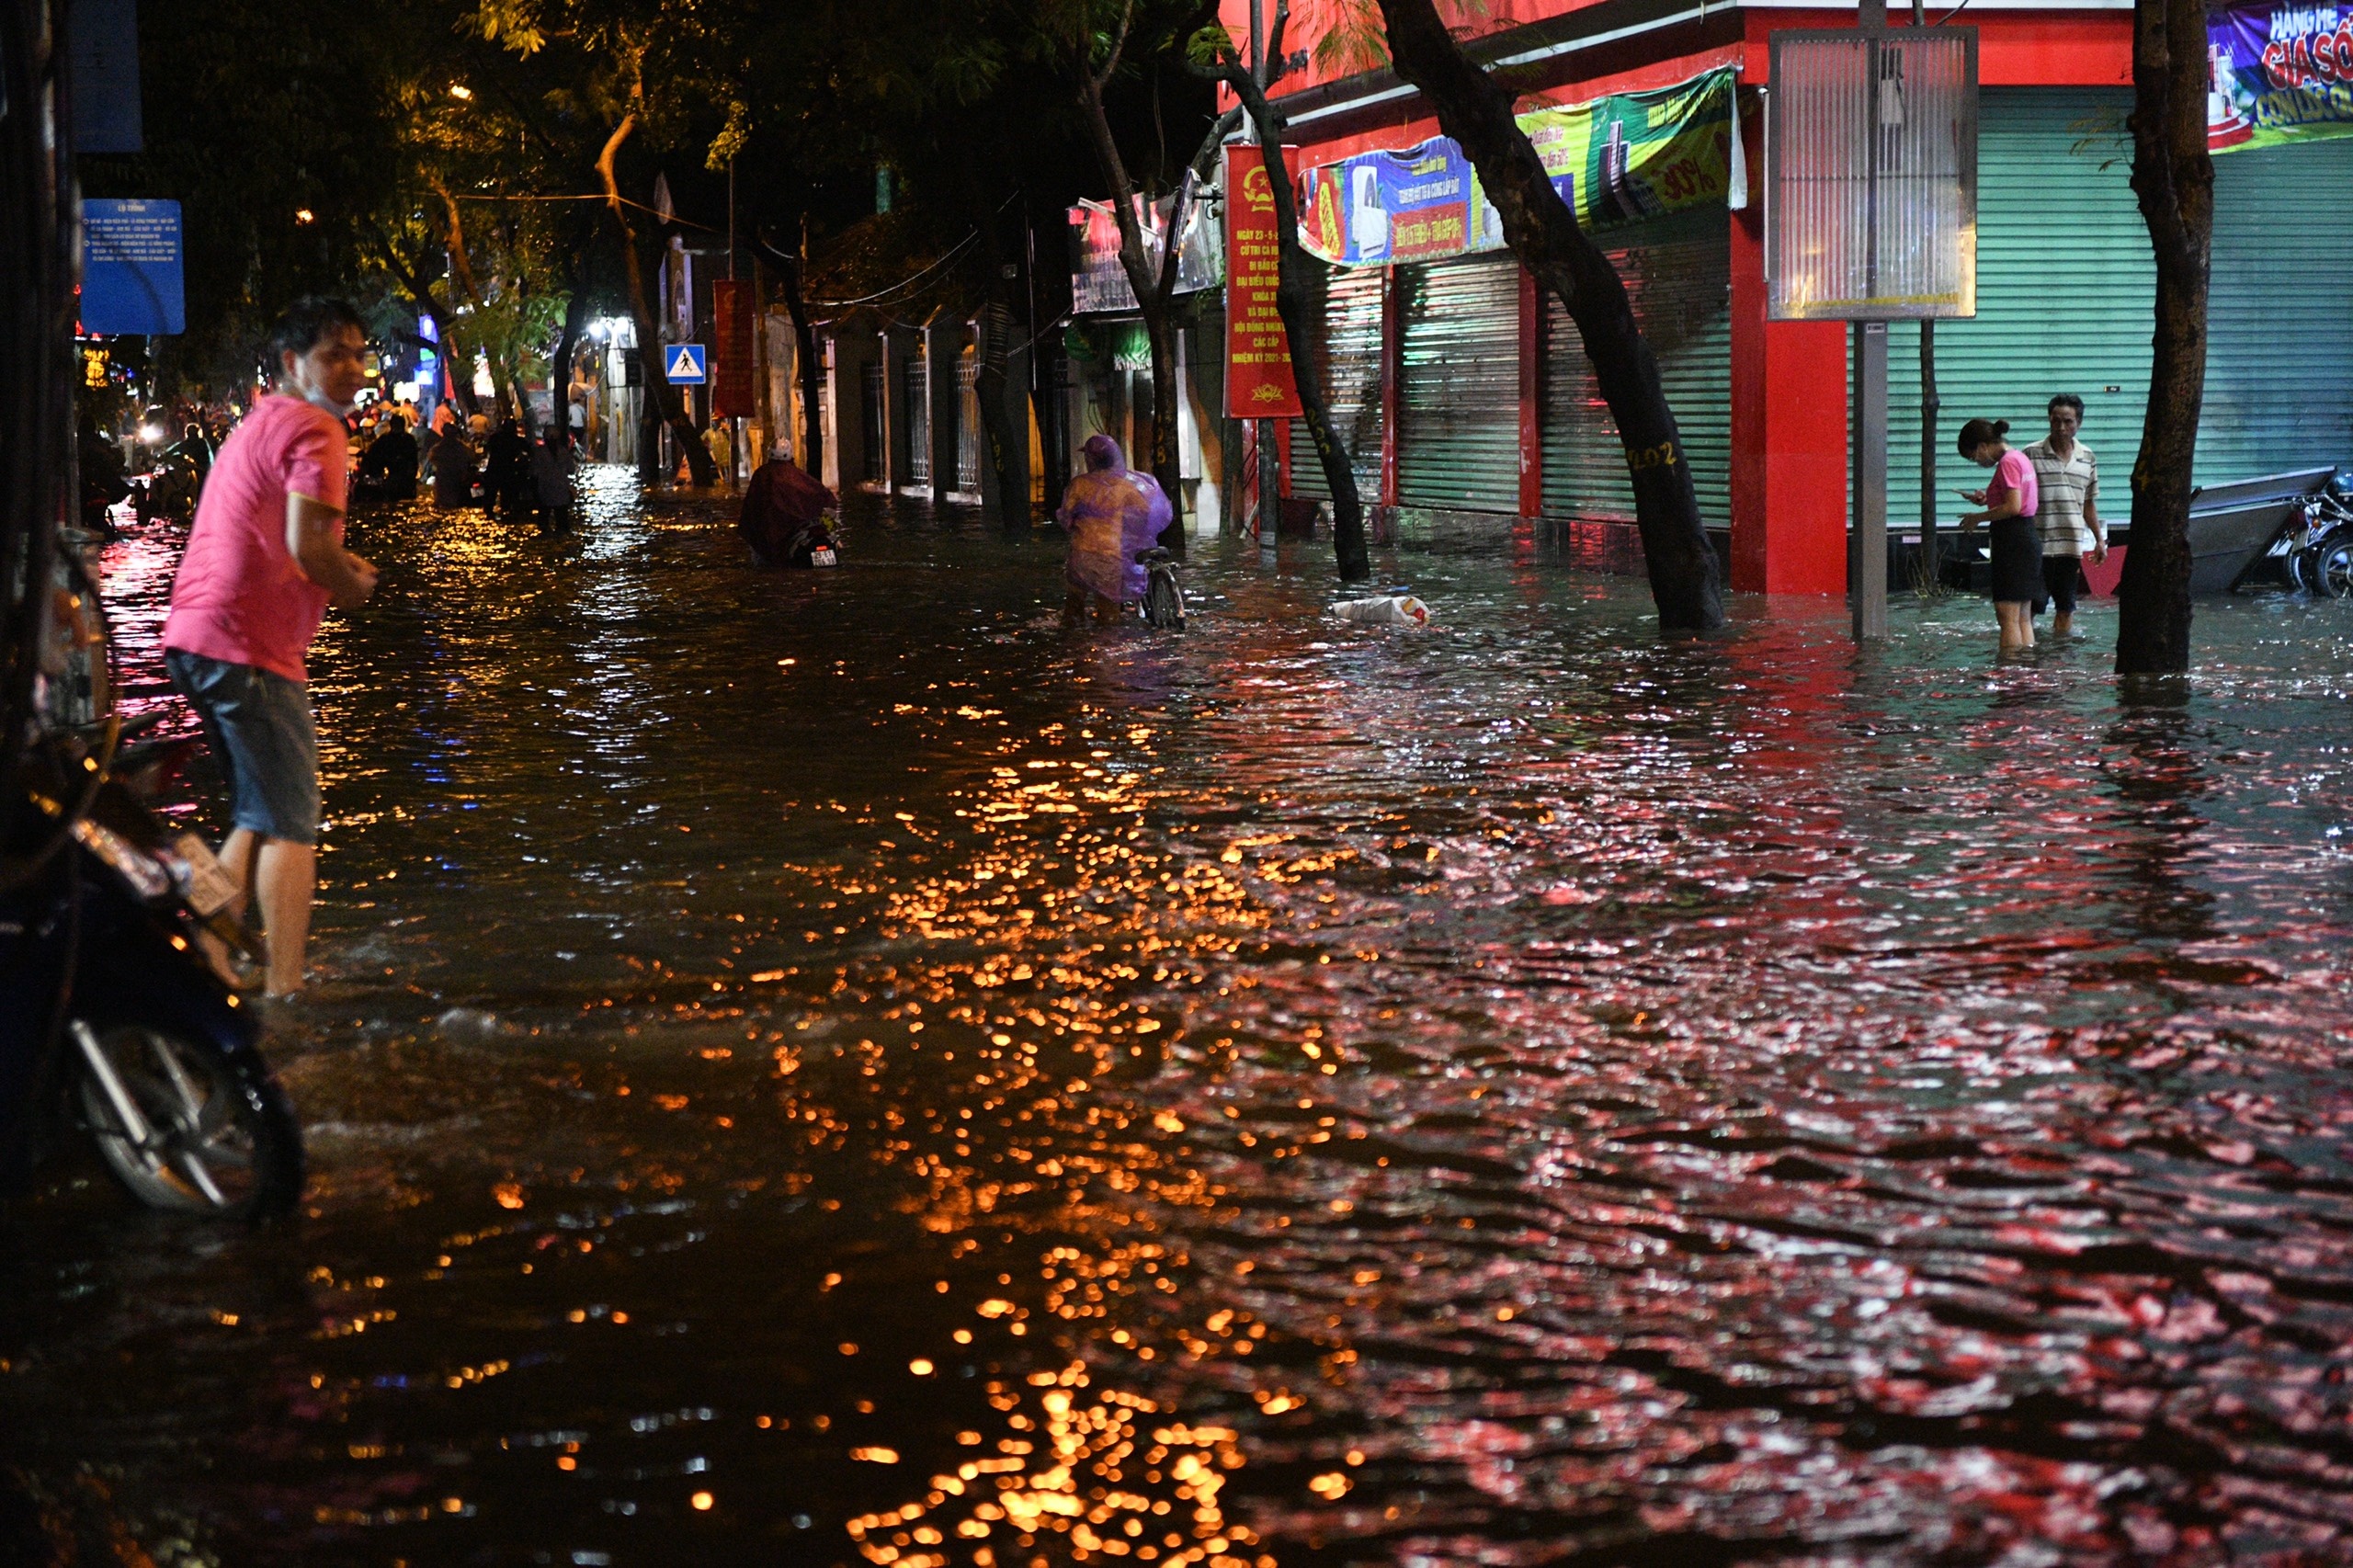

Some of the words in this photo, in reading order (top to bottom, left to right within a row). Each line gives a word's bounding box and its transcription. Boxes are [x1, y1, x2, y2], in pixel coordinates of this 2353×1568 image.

[2262, 30, 2322, 90] GIÁ
[1236, 229, 1254, 241] NGÀY
[1236, 277, 1248, 288] ĐẠI
[1253, 336, 1267, 347] CÁC
[1233, 352, 1254, 365] NHIỆM
